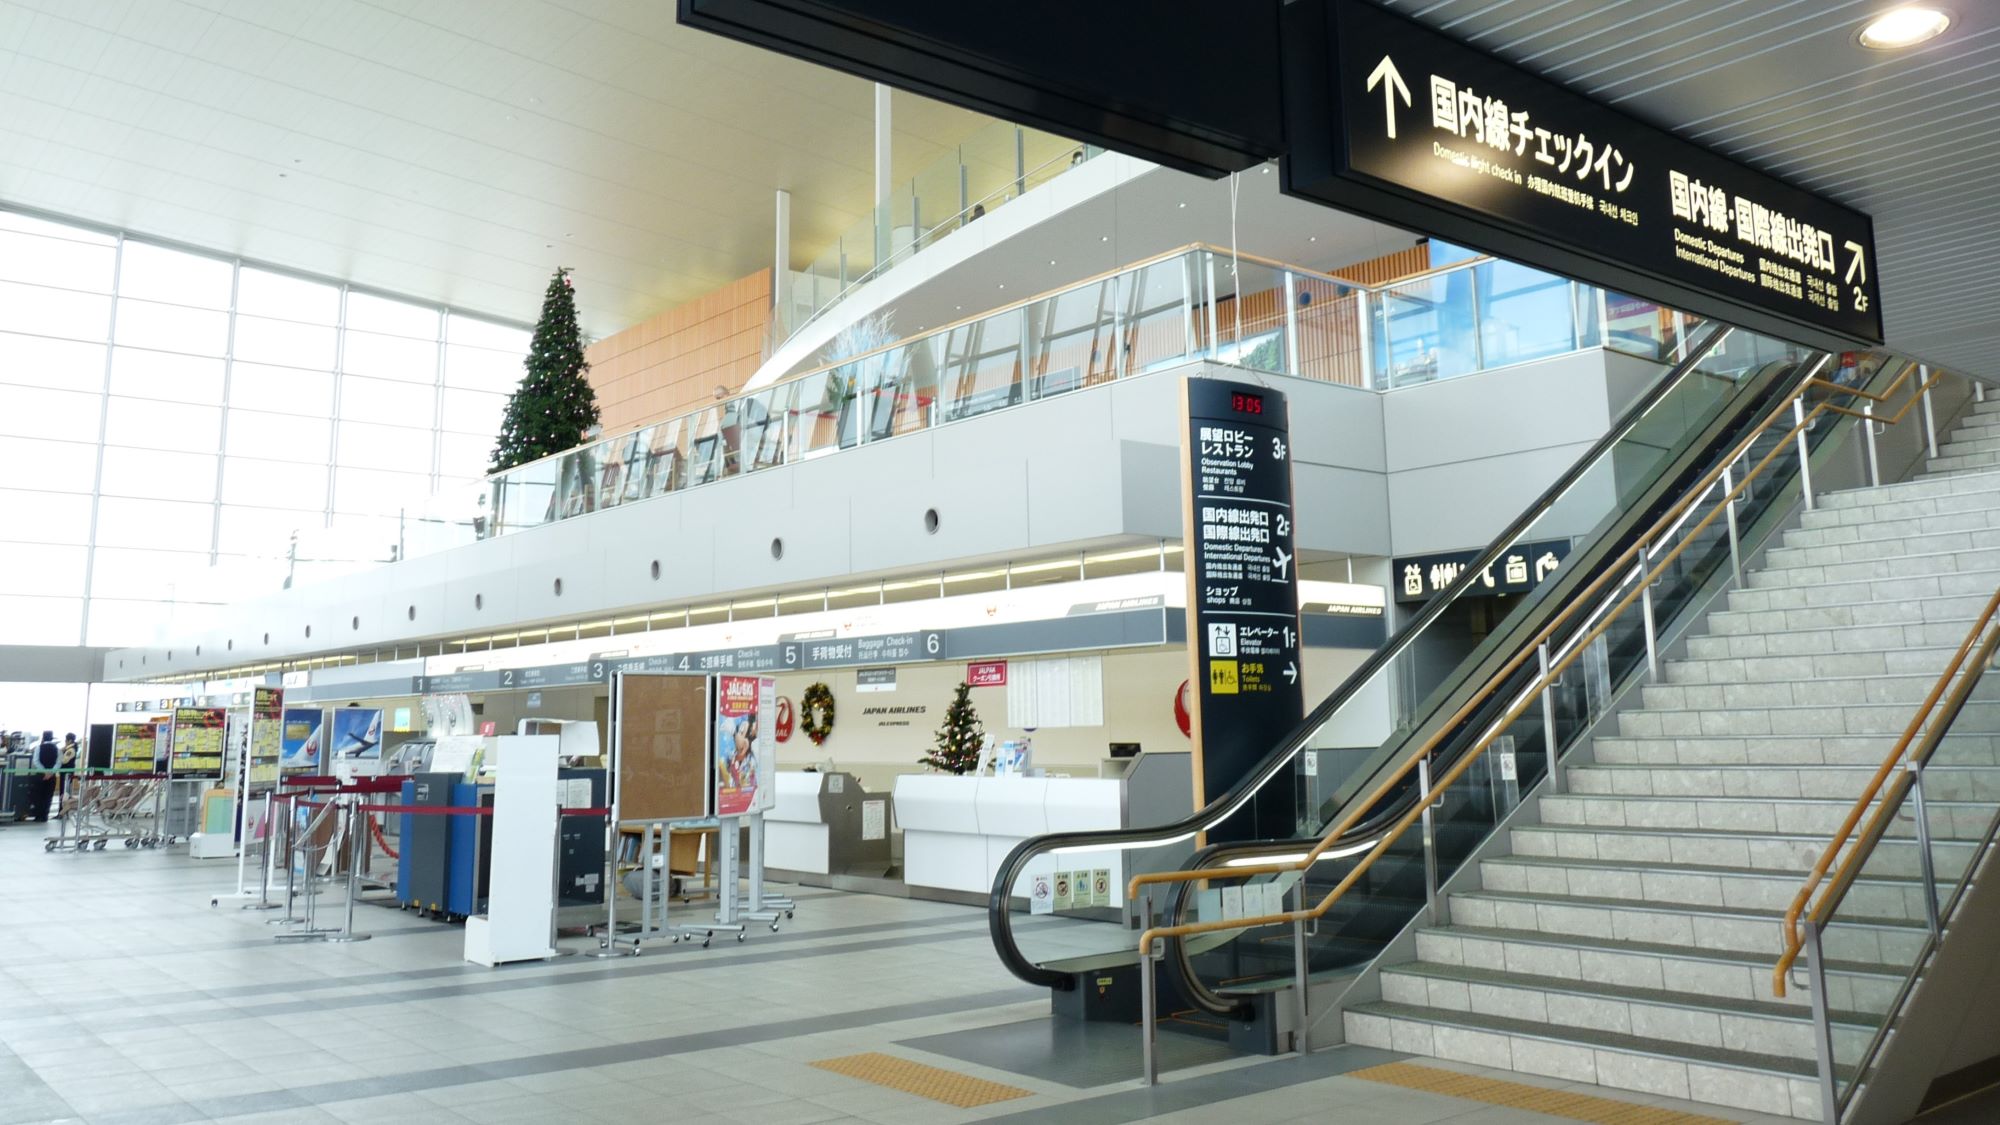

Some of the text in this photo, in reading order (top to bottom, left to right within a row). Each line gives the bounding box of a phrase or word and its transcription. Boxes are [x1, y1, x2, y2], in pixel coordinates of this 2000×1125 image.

[1430, 74, 1634, 192] 国内線チェックイン
[1433, 141, 1470, 168] Domestic
[1491, 163, 1514, 182] check
[1514, 170, 1522, 185] in
[1673, 227, 1745, 265] Domestic Departures
[1675, 244, 1756, 284] International Departures
[1852, 285, 1869, 313] 2F
[1200, 427, 1254, 444] 展望ロビー
[1201, 441, 1254, 458] レストラン
[1271, 436, 1287, 460] 3F
[1201, 457, 1254, 470] Observation Lobby
[1201, 466, 1238, 475] Restaurants
[1202, 506, 1269, 527] 国内線出発口
[1276, 513, 1291, 537] 2F
[1203, 524, 1270, 544] 国際線出発口
[1203, 542, 1264, 553] Domestic Departures
[1204, 551, 1271, 562] International Departures
[1206, 585, 1239, 597] ショップ
[1206, 596, 1227, 604] shops
[1327, 604, 1382, 615] JAPAN AIRLINES
[1239, 625, 1280, 638] エレベーター
[1282, 625, 1297, 649] 1F
[857, 635, 914, 650] Baggage Check-in
[926, 633, 940, 654] 6
[737, 649, 760, 659] Check-in
[785, 646, 797, 664] 5
[812, 644, 853, 661] 手荷物受付
[592, 662, 604, 679] 3
[678, 655, 691, 672] 4
[417, 678, 424, 691] 1
[503, 670, 513, 686] 2
[135, 701, 144, 711] 2
[161, 698, 168, 709] 3
[863, 705, 927, 716] JAPAN AIRLINES
